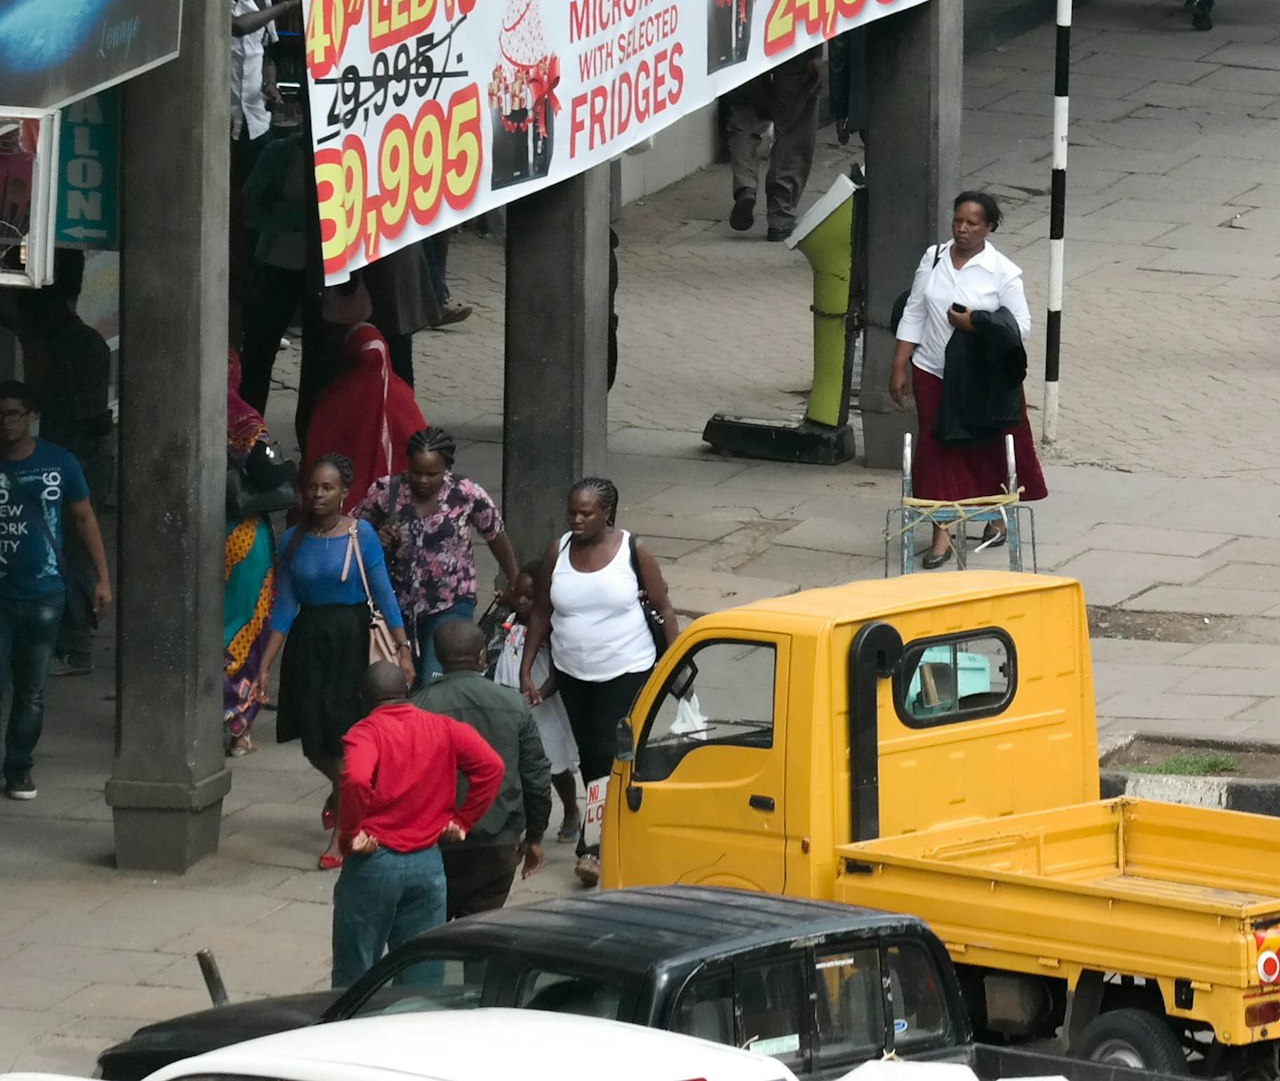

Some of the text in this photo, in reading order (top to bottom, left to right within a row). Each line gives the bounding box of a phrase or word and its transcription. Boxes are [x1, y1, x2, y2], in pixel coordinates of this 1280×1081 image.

[578, 4, 678, 84] WITH SELECTED
[570, 42, 685, 160] FRIDGES
[315, 98, 480, 262] 39,995
[0, 504, 23, 517] EW
[0, 521, 28, 535] ORK
[2, 540, 20, 553] TY
